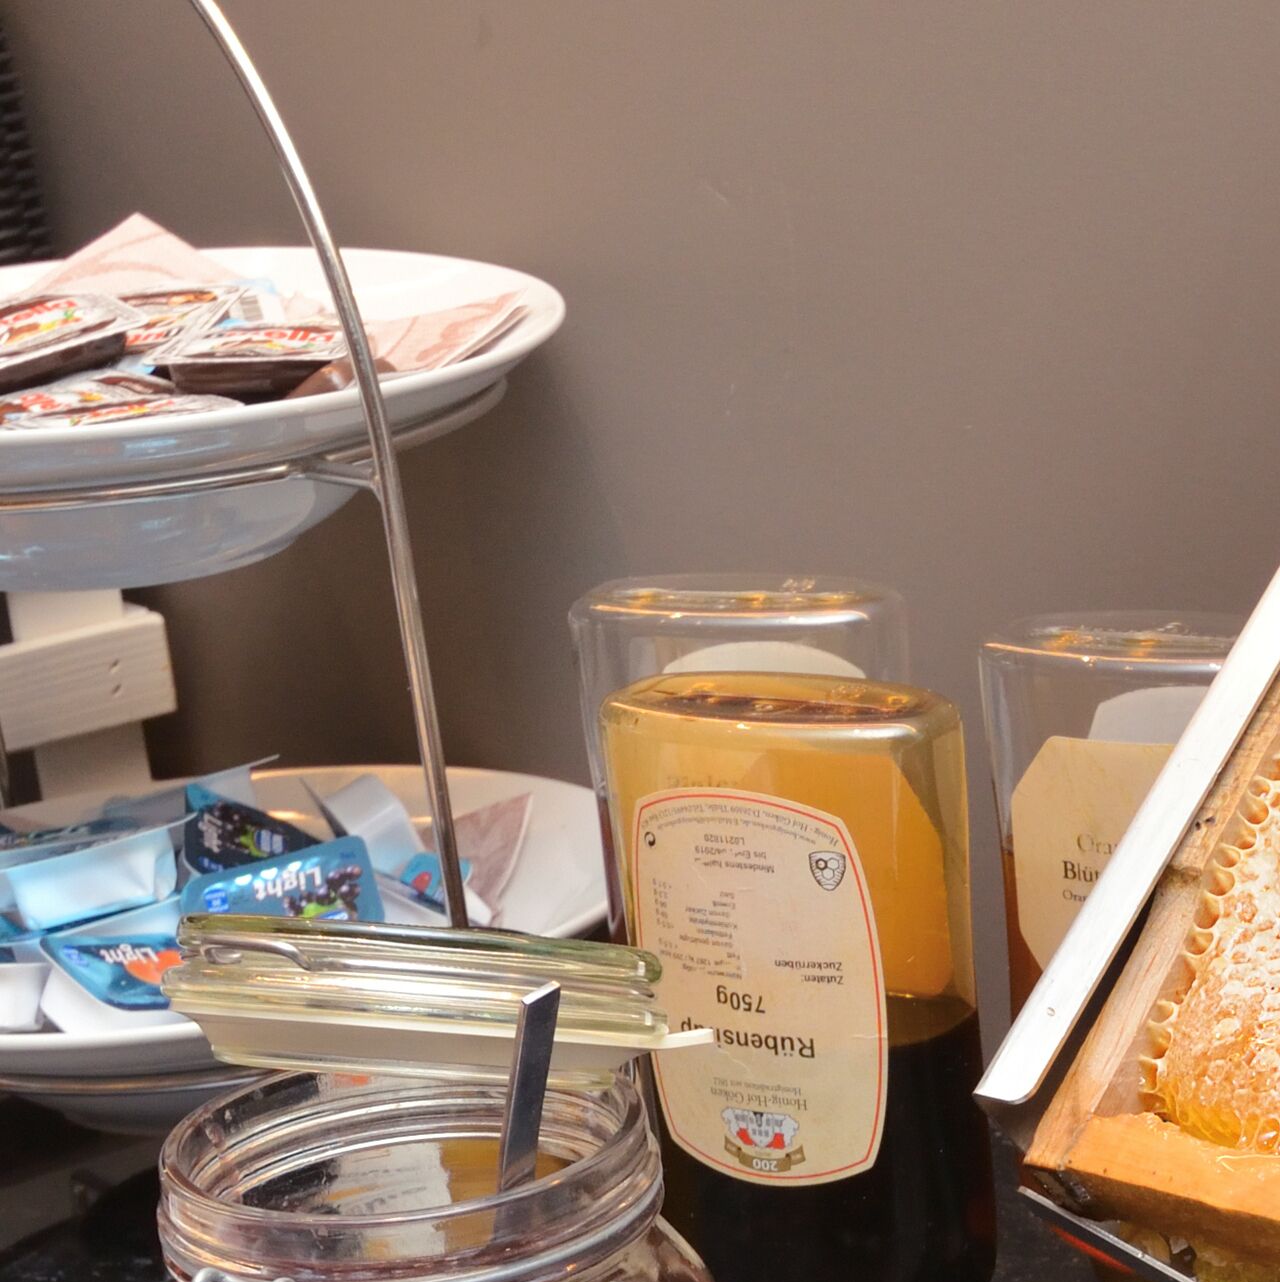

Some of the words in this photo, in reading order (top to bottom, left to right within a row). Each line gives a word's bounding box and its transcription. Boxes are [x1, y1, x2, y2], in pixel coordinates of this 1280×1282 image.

[253, 865, 322, 900] Light
[100, 944, 159, 965] Light
[775, 959, 843, 971] Zuckerrüben
[801, 974, 844, 985] Zutaten:
[716, 985, 766, 1013] 750g
[681, 1017, 815, 1058] Rübensip
[752, 1158, 778, 1171] 200
